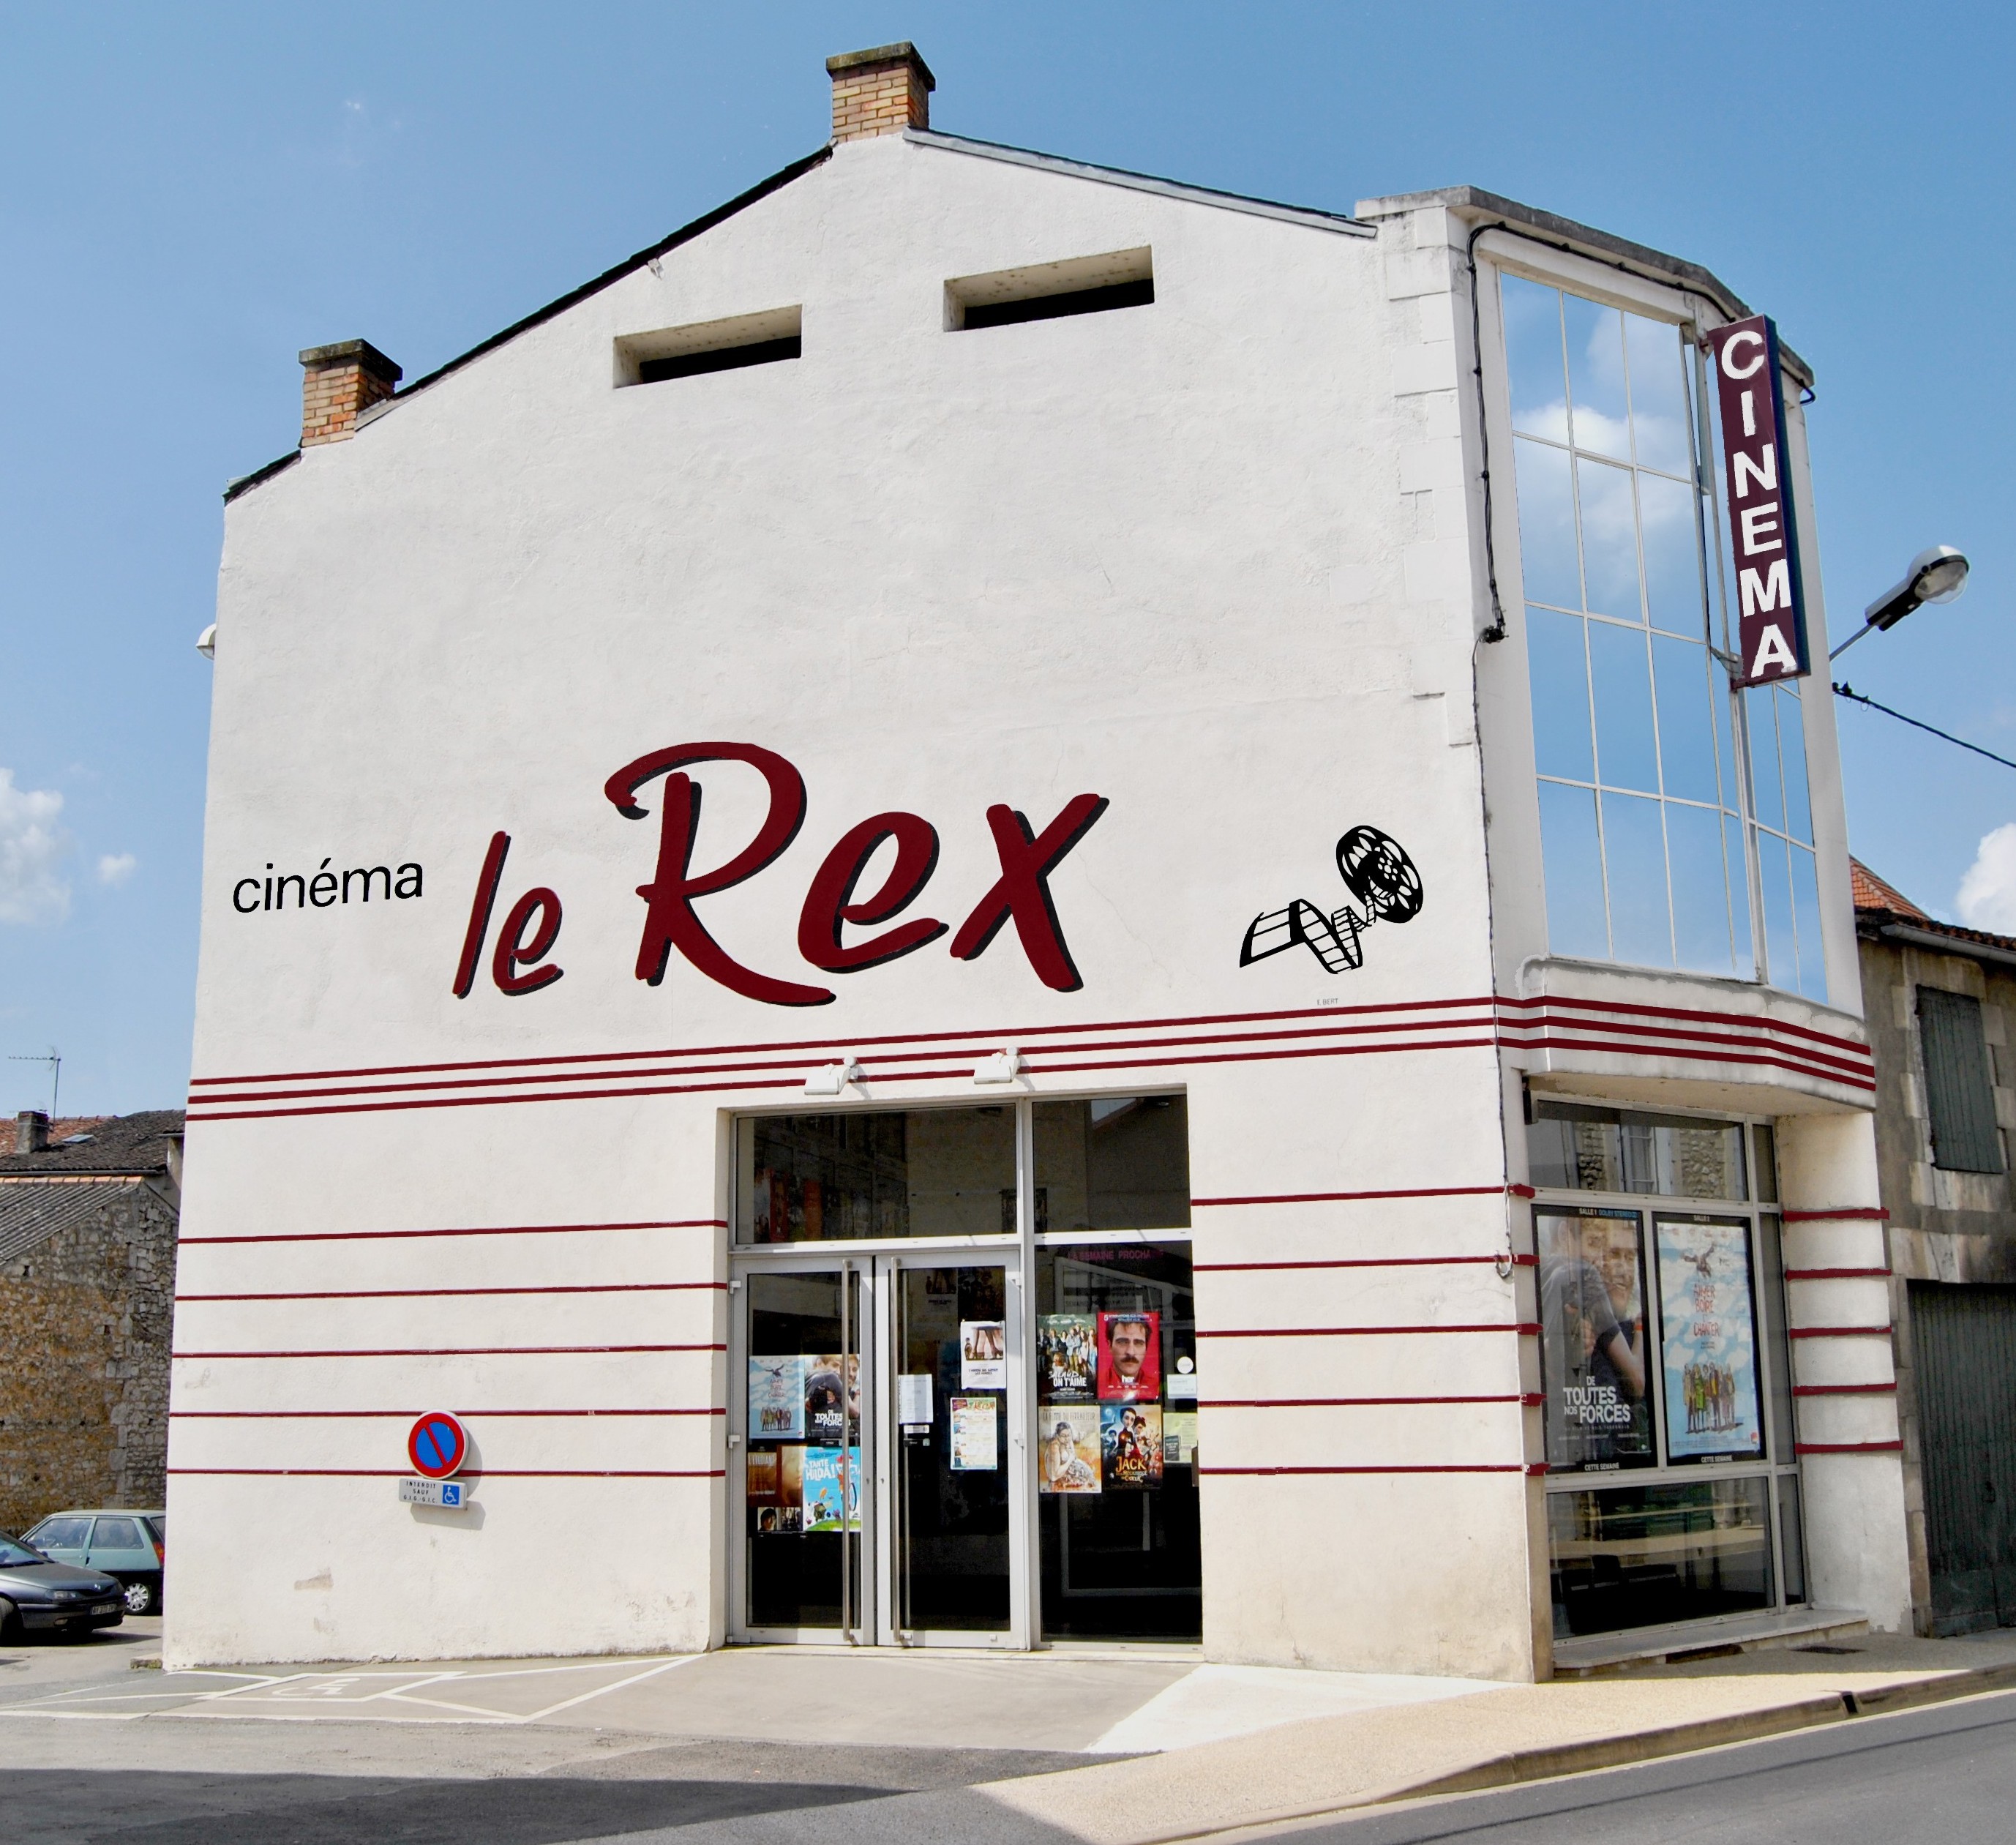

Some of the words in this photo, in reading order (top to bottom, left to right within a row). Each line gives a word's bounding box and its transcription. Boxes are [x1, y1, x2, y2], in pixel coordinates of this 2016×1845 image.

[1721, 330, 1797, 678] CINEMA
[233, 857, 423, 913] cinéma
[452, 831, 565, 1000] le
[604, 741, 1111, 1008] Rex
[1053, 1377, 1063, 1387] ON
[1586, 1376, 1595, 1386] DE
[1563, 1385, 1616, 1405] TOUTES
[1564, 1406, 1578, 1415] NOS
[1579, 1404, 1631, 1423] FORCES
[809, 1459, 829, 1468] TANTE
[1115, 1456, 1147, 1472] JACK
[1600, 1462, 1620, 1470] SEMAINE
[406, 1481, 436, 1489] INTERDIT
